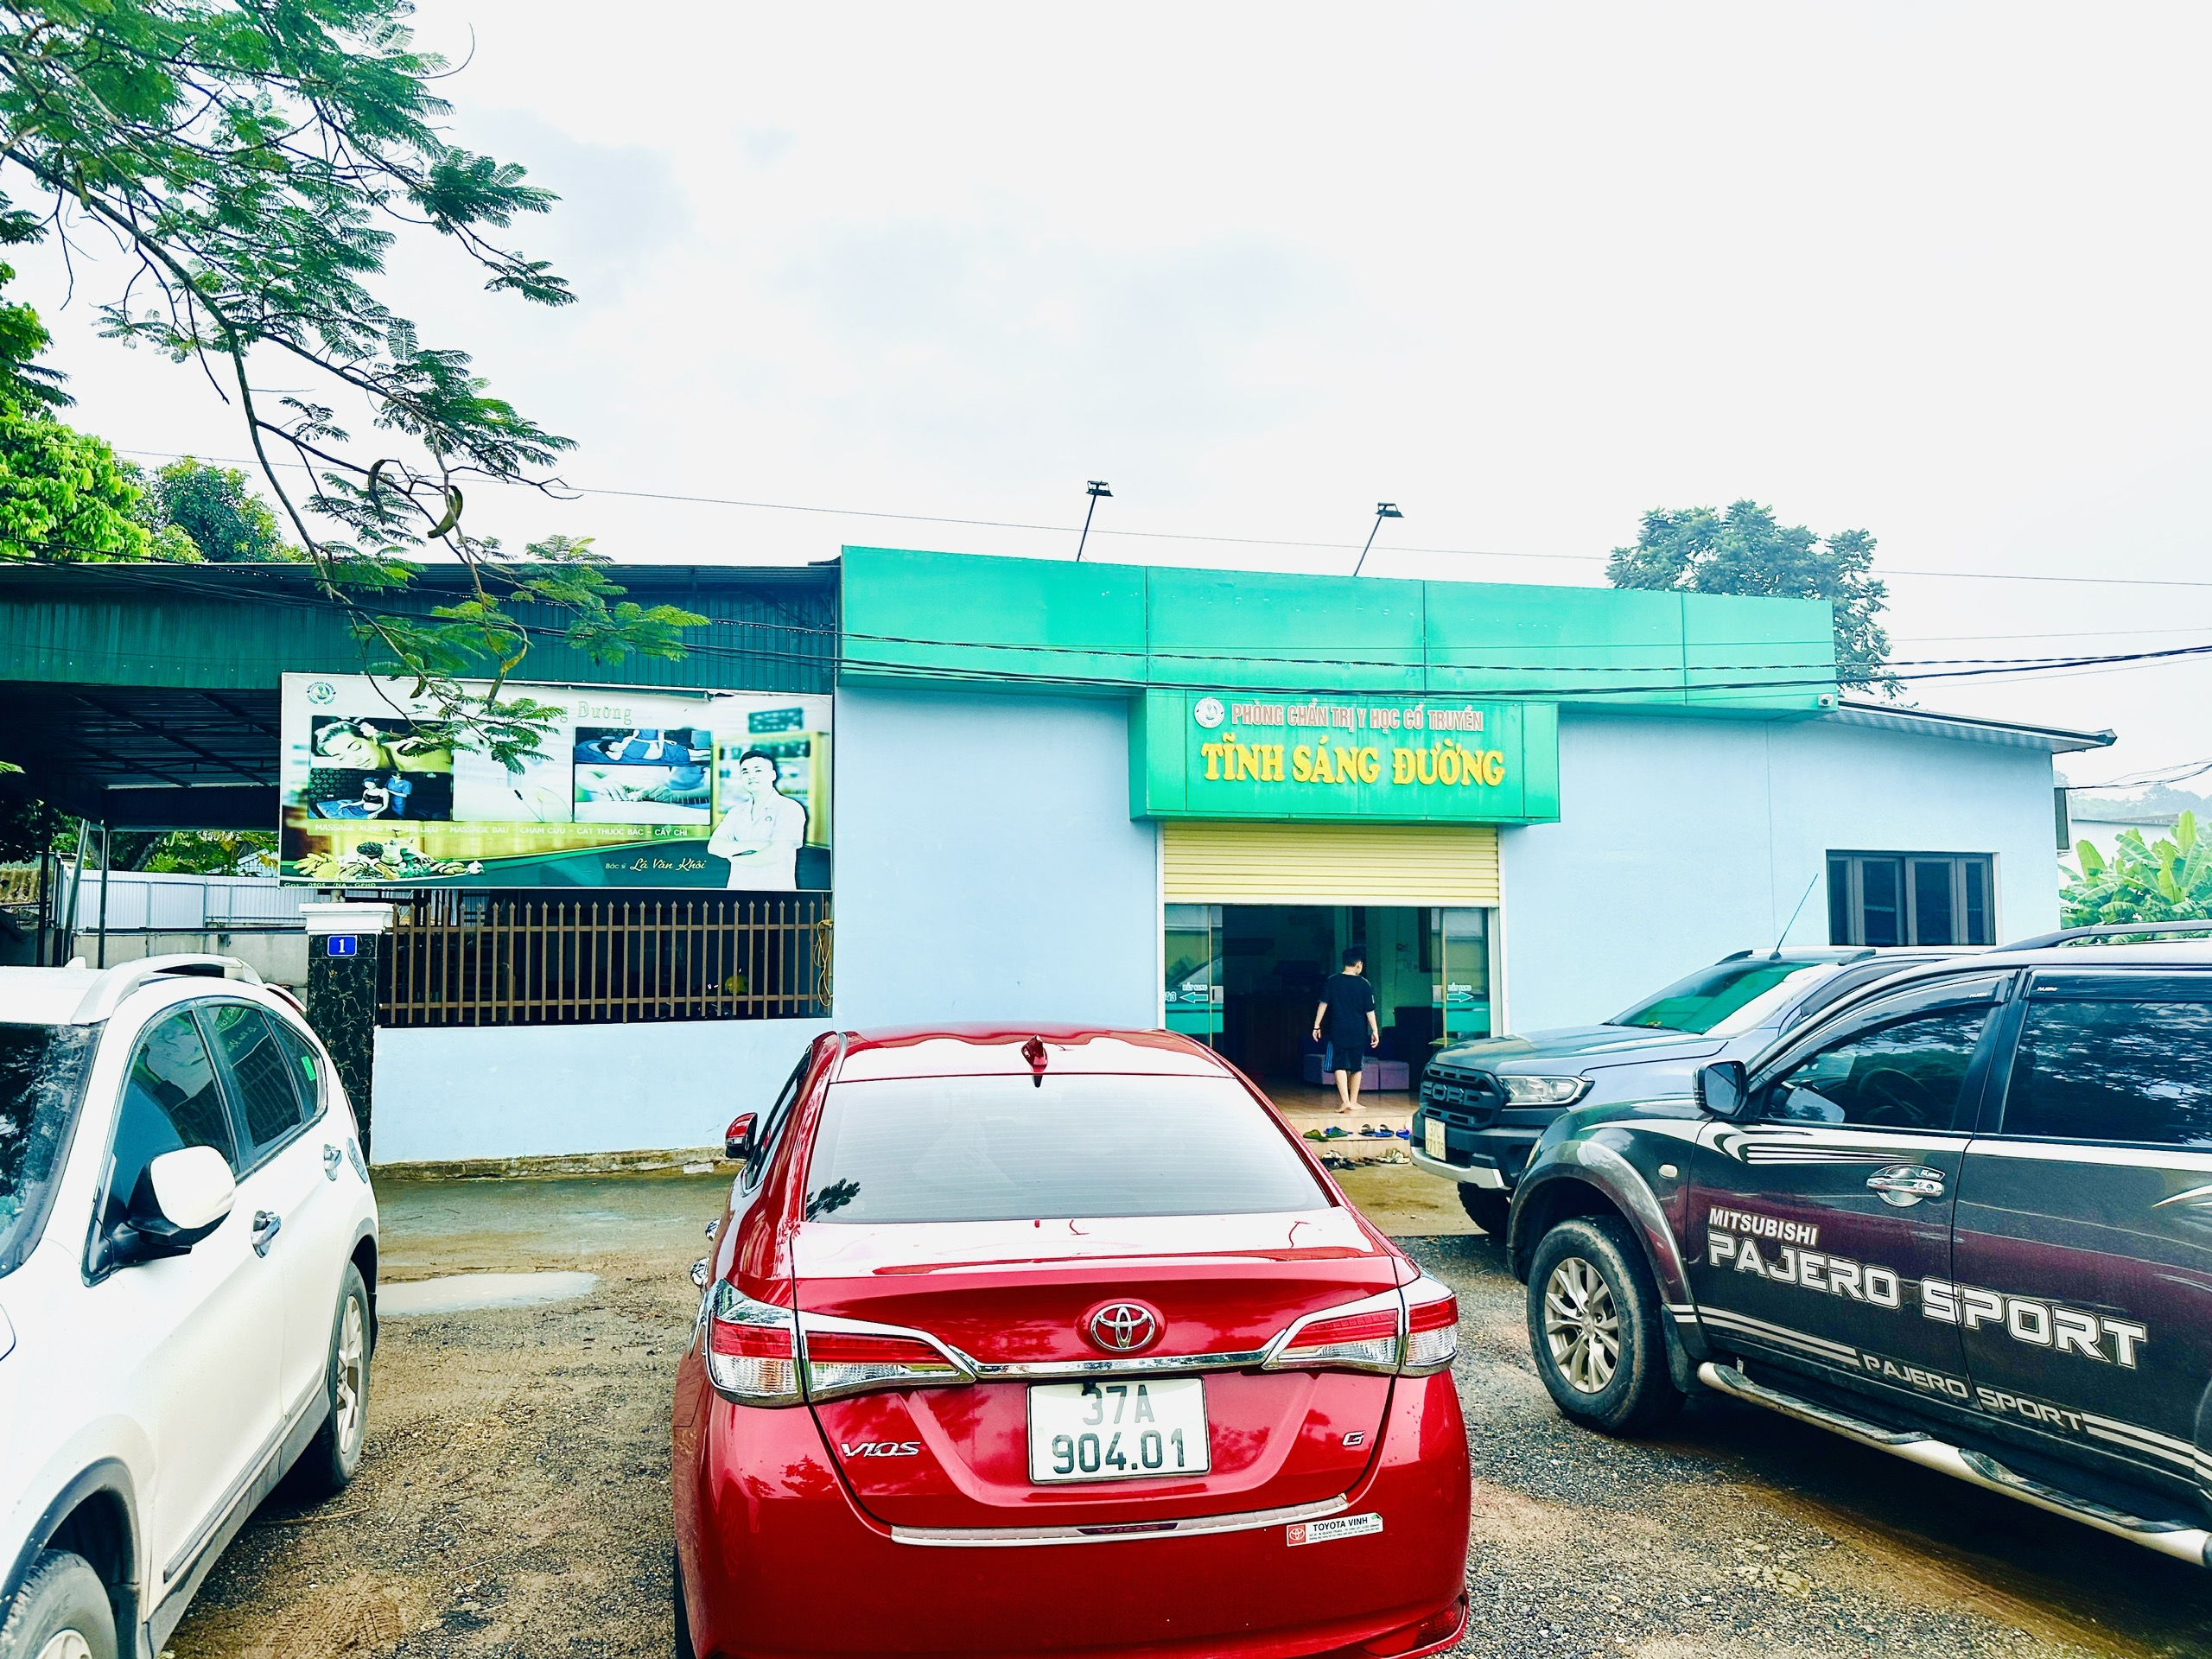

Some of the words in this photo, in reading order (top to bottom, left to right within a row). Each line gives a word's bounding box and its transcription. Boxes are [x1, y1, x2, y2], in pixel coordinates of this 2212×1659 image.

[1231, 698, 1284, 725] PHÒNG
[1331, 707, 1354, 733] TRỊ
[1357, 708, 1367, 728] Y
[1370, 709, 1400, 734] HỌC
[1201, 732, 1285, 782] TĨNH
[1293, 734, 1382, 784] SÁNG
[1392, 738, 1505, 786] ĐƯỜNG
[675, 857, 707, 872] Khôi
[339, 938, 346, 953] 1
[1421, 1081, 1480, 1105] FORD
[1708, 1206, 1819, 1246] MITSUBISHI
[1707, 1230, 1900, 1309] PAJERO
[1920, 1275, 2147, 1369] SPORT
[1081, 1383, 1155, 1426] 37A
[1863, 1355, 1969, 1399] PAJERO
[1976, 1386, 2083, 1432] SPORT
[841, 1440, 921, 1458] VIOS
[1052, 1427, 1185, 1474] 904.01
[1342, 1430, 1365, 1446] G
[1313, 1520, 1346, 1532] TOYOTA
[1348, 1516, 1368, 1527] VINH
